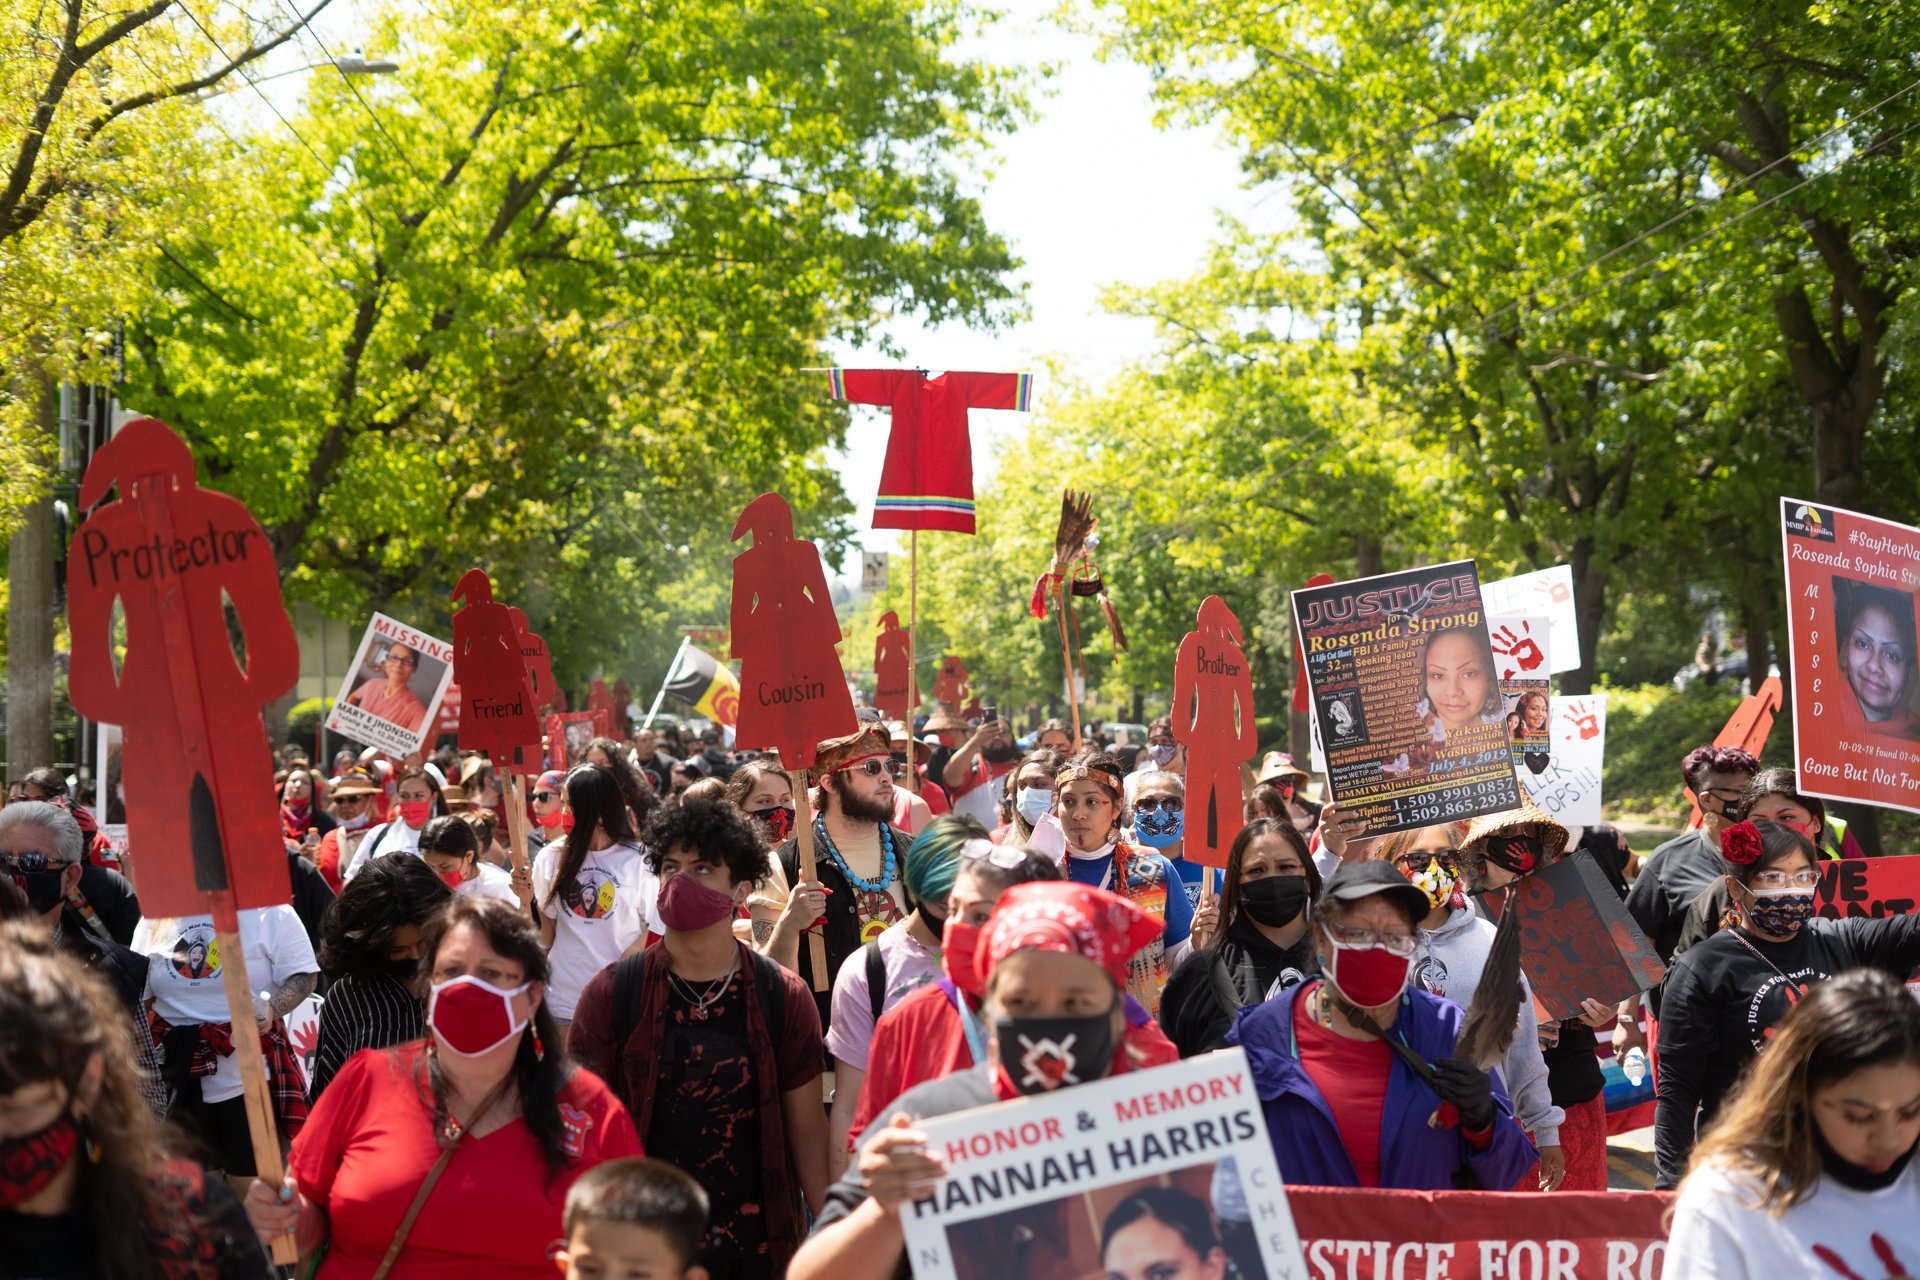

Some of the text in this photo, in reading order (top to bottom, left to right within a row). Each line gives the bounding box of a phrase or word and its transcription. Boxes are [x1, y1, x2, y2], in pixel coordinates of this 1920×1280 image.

[83, 520, 257, 588] Protector
[1792, 543, 1850, 569] Rosenda
[1854, 556, 1897, 579] Sophia
[1301, 575, 1475, 625] JUSTICE
[1309, 608, 1479, 651] Rosenda Strong
[1386, 614, 1400, 625] for
[374, 618, 453, 663] MISSING
[1353, 637, 1424, 656] FBI & Family are
[1197, 646, 1241, 677] Brother
[1316, 653, 1326, 663] Life
[1337, 648, 1351, 657] Short
[1326, 659, 1341, 671] 32
[1355, 649, 1415, 668] Seeking leads
[1357, 662, 1400, 677] surrounding
[1358, 671, 1400, 685] disappearance
[758, 675, 824, 707] Cousin
[1362, 693, 1383, 702] Rosenda
[1367, 681, 1394, 692] Rosenda
[472, 692, 524, 719] Friend
[337, 703, 365, 720] MARY
[367, 715, 372, 723] E
[373, 719, 419, 744] JHONSON
[1446, 720, 1501, 738] Yakama
[1435, 738, 1505, 761] Washington
[1445, 729, 1503, 746] Reservation
[1428, 757, 1456, 774] July
[1459, 755, 1470, 767] 4,
[1475, 747, 1507, 763] 2019
[1876, 746, 1898, 759] found
[1332, 759, 1381, 774] Report Anonymous
[1804, 757, 1839, 777] Gone
[1844, 763, 1868, 782] But
[1872, 766, 1896, 787] Not
[1358, 778, 1514, 817] Tipline: 1.509.990.0857
[1373, 814, 1396, 823] Nation
[1396, 791, 1516, 823] 1.509.865.2933
[1748, 984, 1770, 1023] JUSTICE
[945, 1072, 1245, 1165] HONOR & MEMORY
[912, 1111, 1257, 1218] HANNAH HARRIS
[1300, 1238, 1455, 1280] STICE
[1478, 1240, 1580, 1280] FOR
